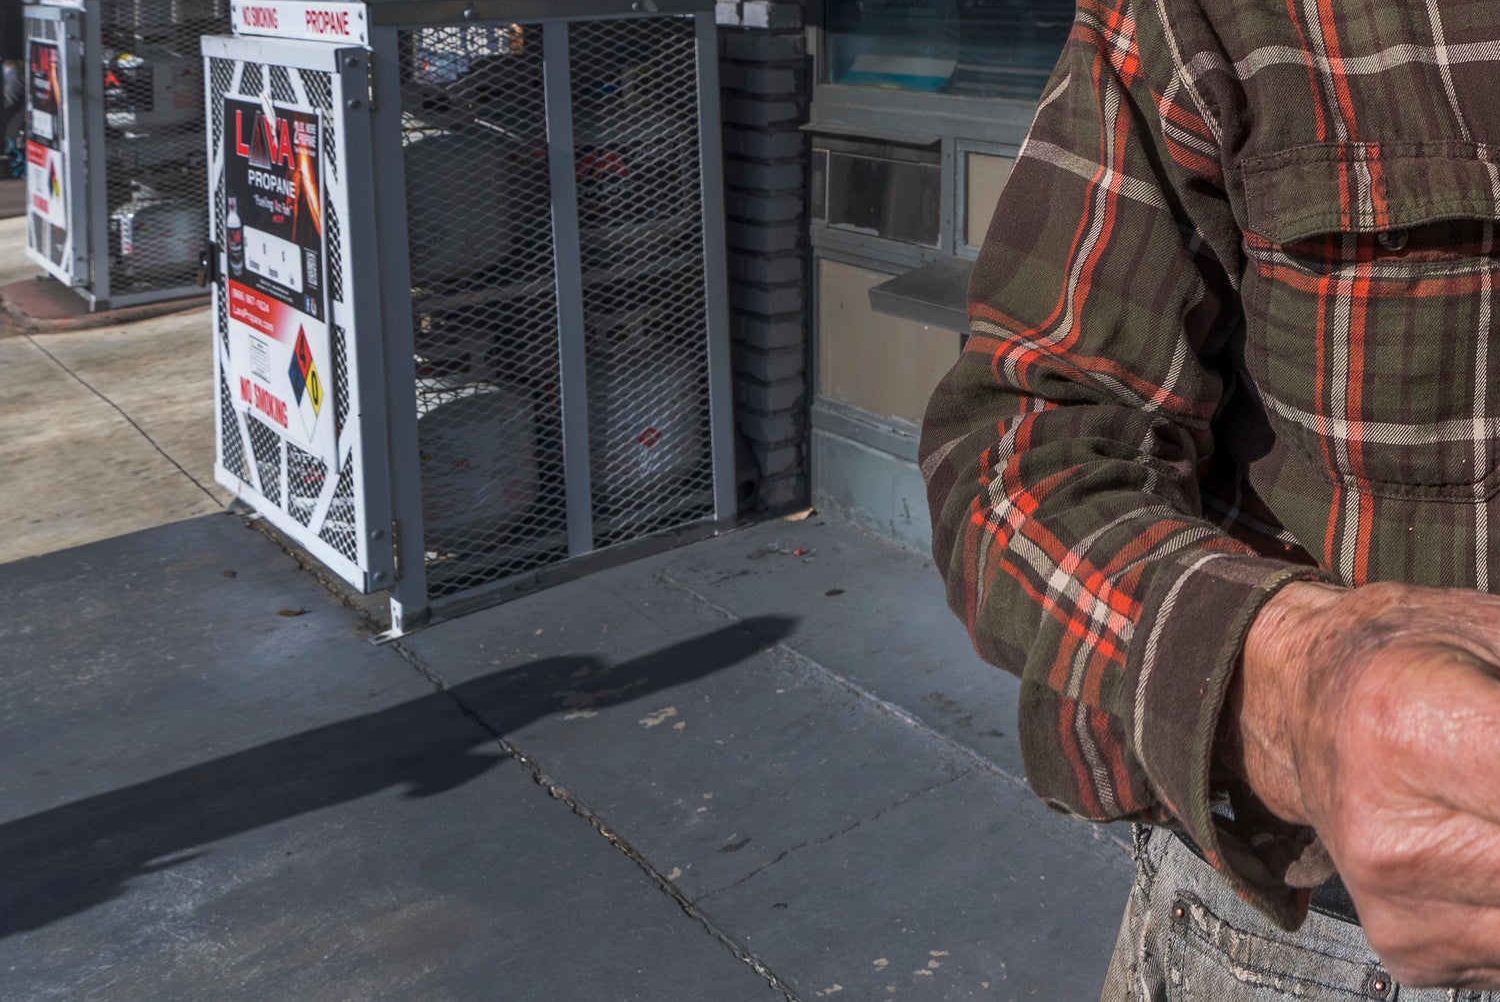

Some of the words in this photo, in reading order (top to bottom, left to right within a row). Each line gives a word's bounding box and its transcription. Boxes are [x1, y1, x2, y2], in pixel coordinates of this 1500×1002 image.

[242, 6, 251, 27] NO
[252, 6, 278, 29] SMOKING
[305, 10, 350, 36] PROPANE
[236, 109, 295, 170] LAVA
[248, 169, 296, 199] PROPANE
[240, 376, 252, 405] NO
[254, 383, 288, 429] SMOKING
[311, 370, 319, 406] 0
